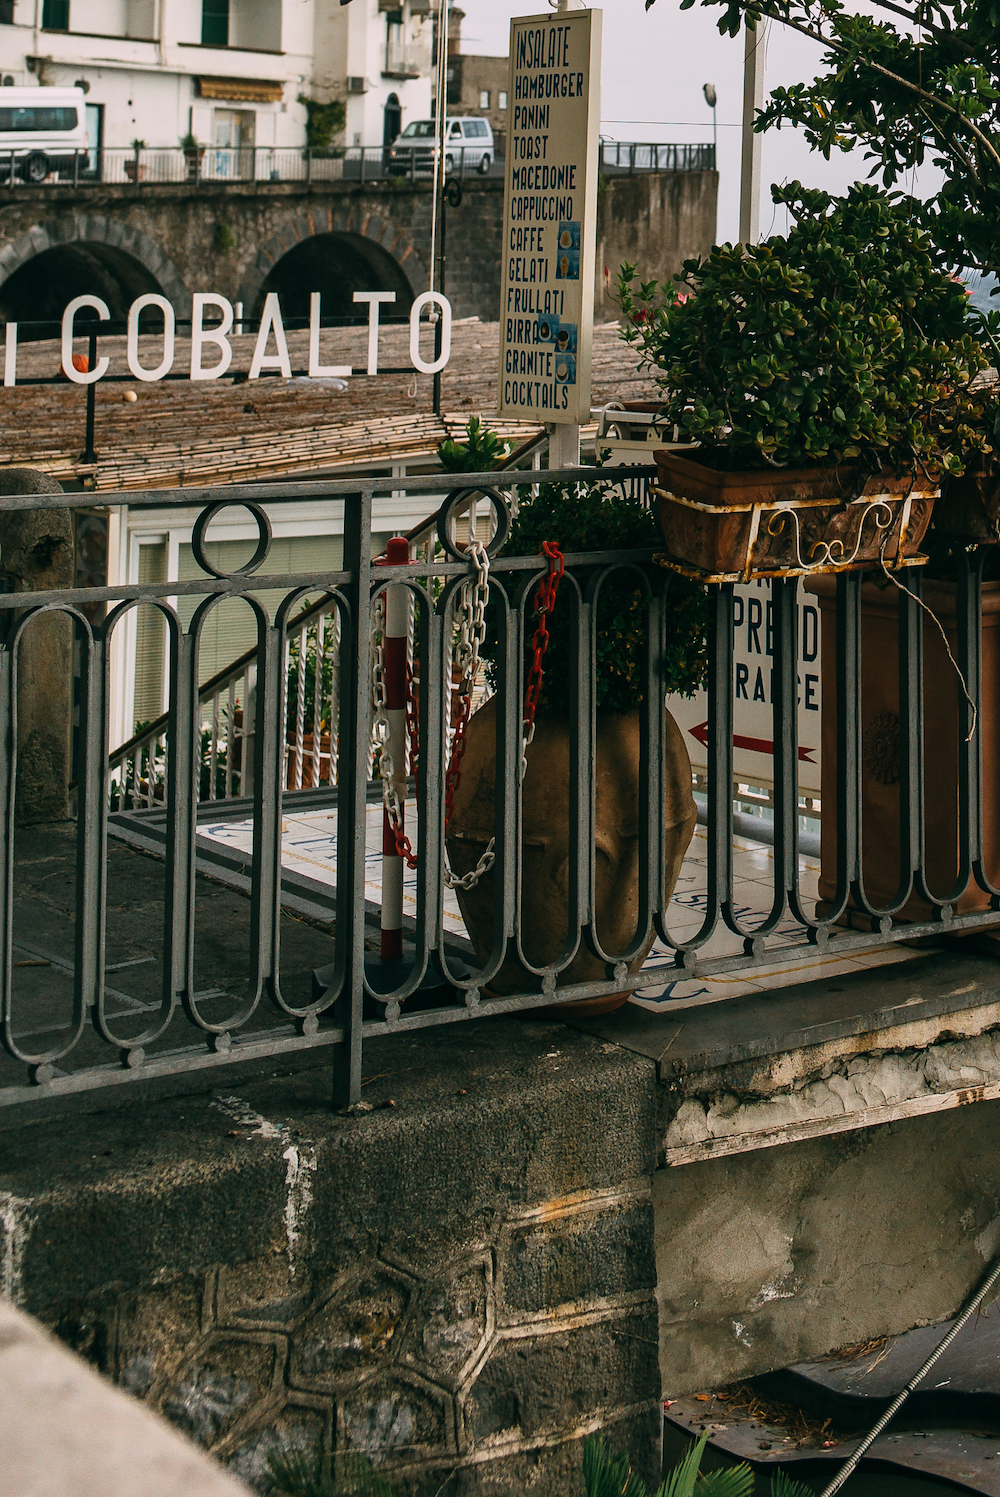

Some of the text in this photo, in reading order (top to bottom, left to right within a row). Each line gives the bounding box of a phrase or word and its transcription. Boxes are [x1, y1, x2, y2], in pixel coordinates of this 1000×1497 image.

[516, 26, 571, 69] INSALATE
[515, 72, 584, 100] HAMBURGER
[514, 105, 550, 130] PANINI
[513, 135, 548, 160] TOAST
[512, 165, 577, 190] MACEDONIE
[511, 196, 573, 221] CAPPUCCINO
[508, 258, 549, 283] GELATI
[507, 287, 564, 315] FRULLATI
[61, 291, 453, 384] COBALTO
[506, 318, 539, 344] BIRRA
[505, 349, 553, 377] GRANITE
[504, 380, 569, 410] COCKTAILS
